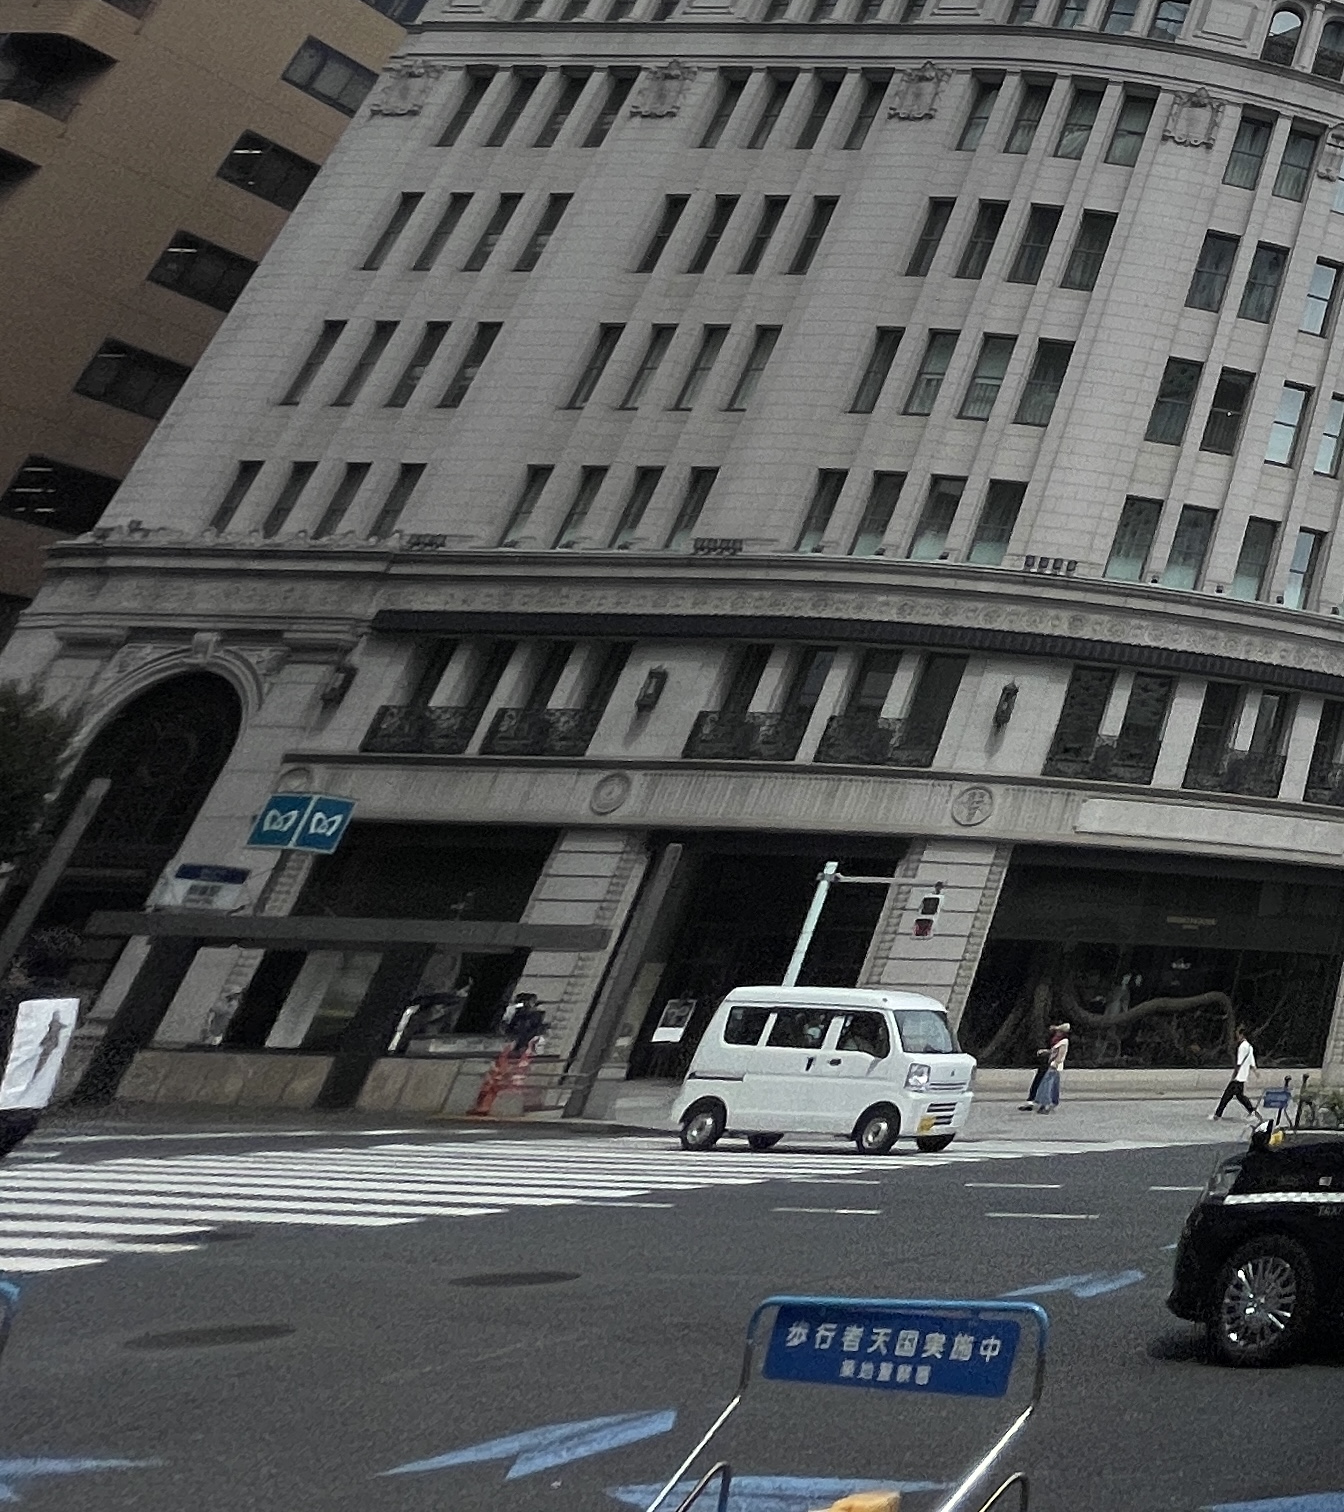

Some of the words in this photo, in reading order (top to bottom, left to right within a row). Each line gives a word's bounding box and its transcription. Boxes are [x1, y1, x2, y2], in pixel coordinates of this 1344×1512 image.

[785, 1320, 1002, 1363] 歩行者天国実施中
